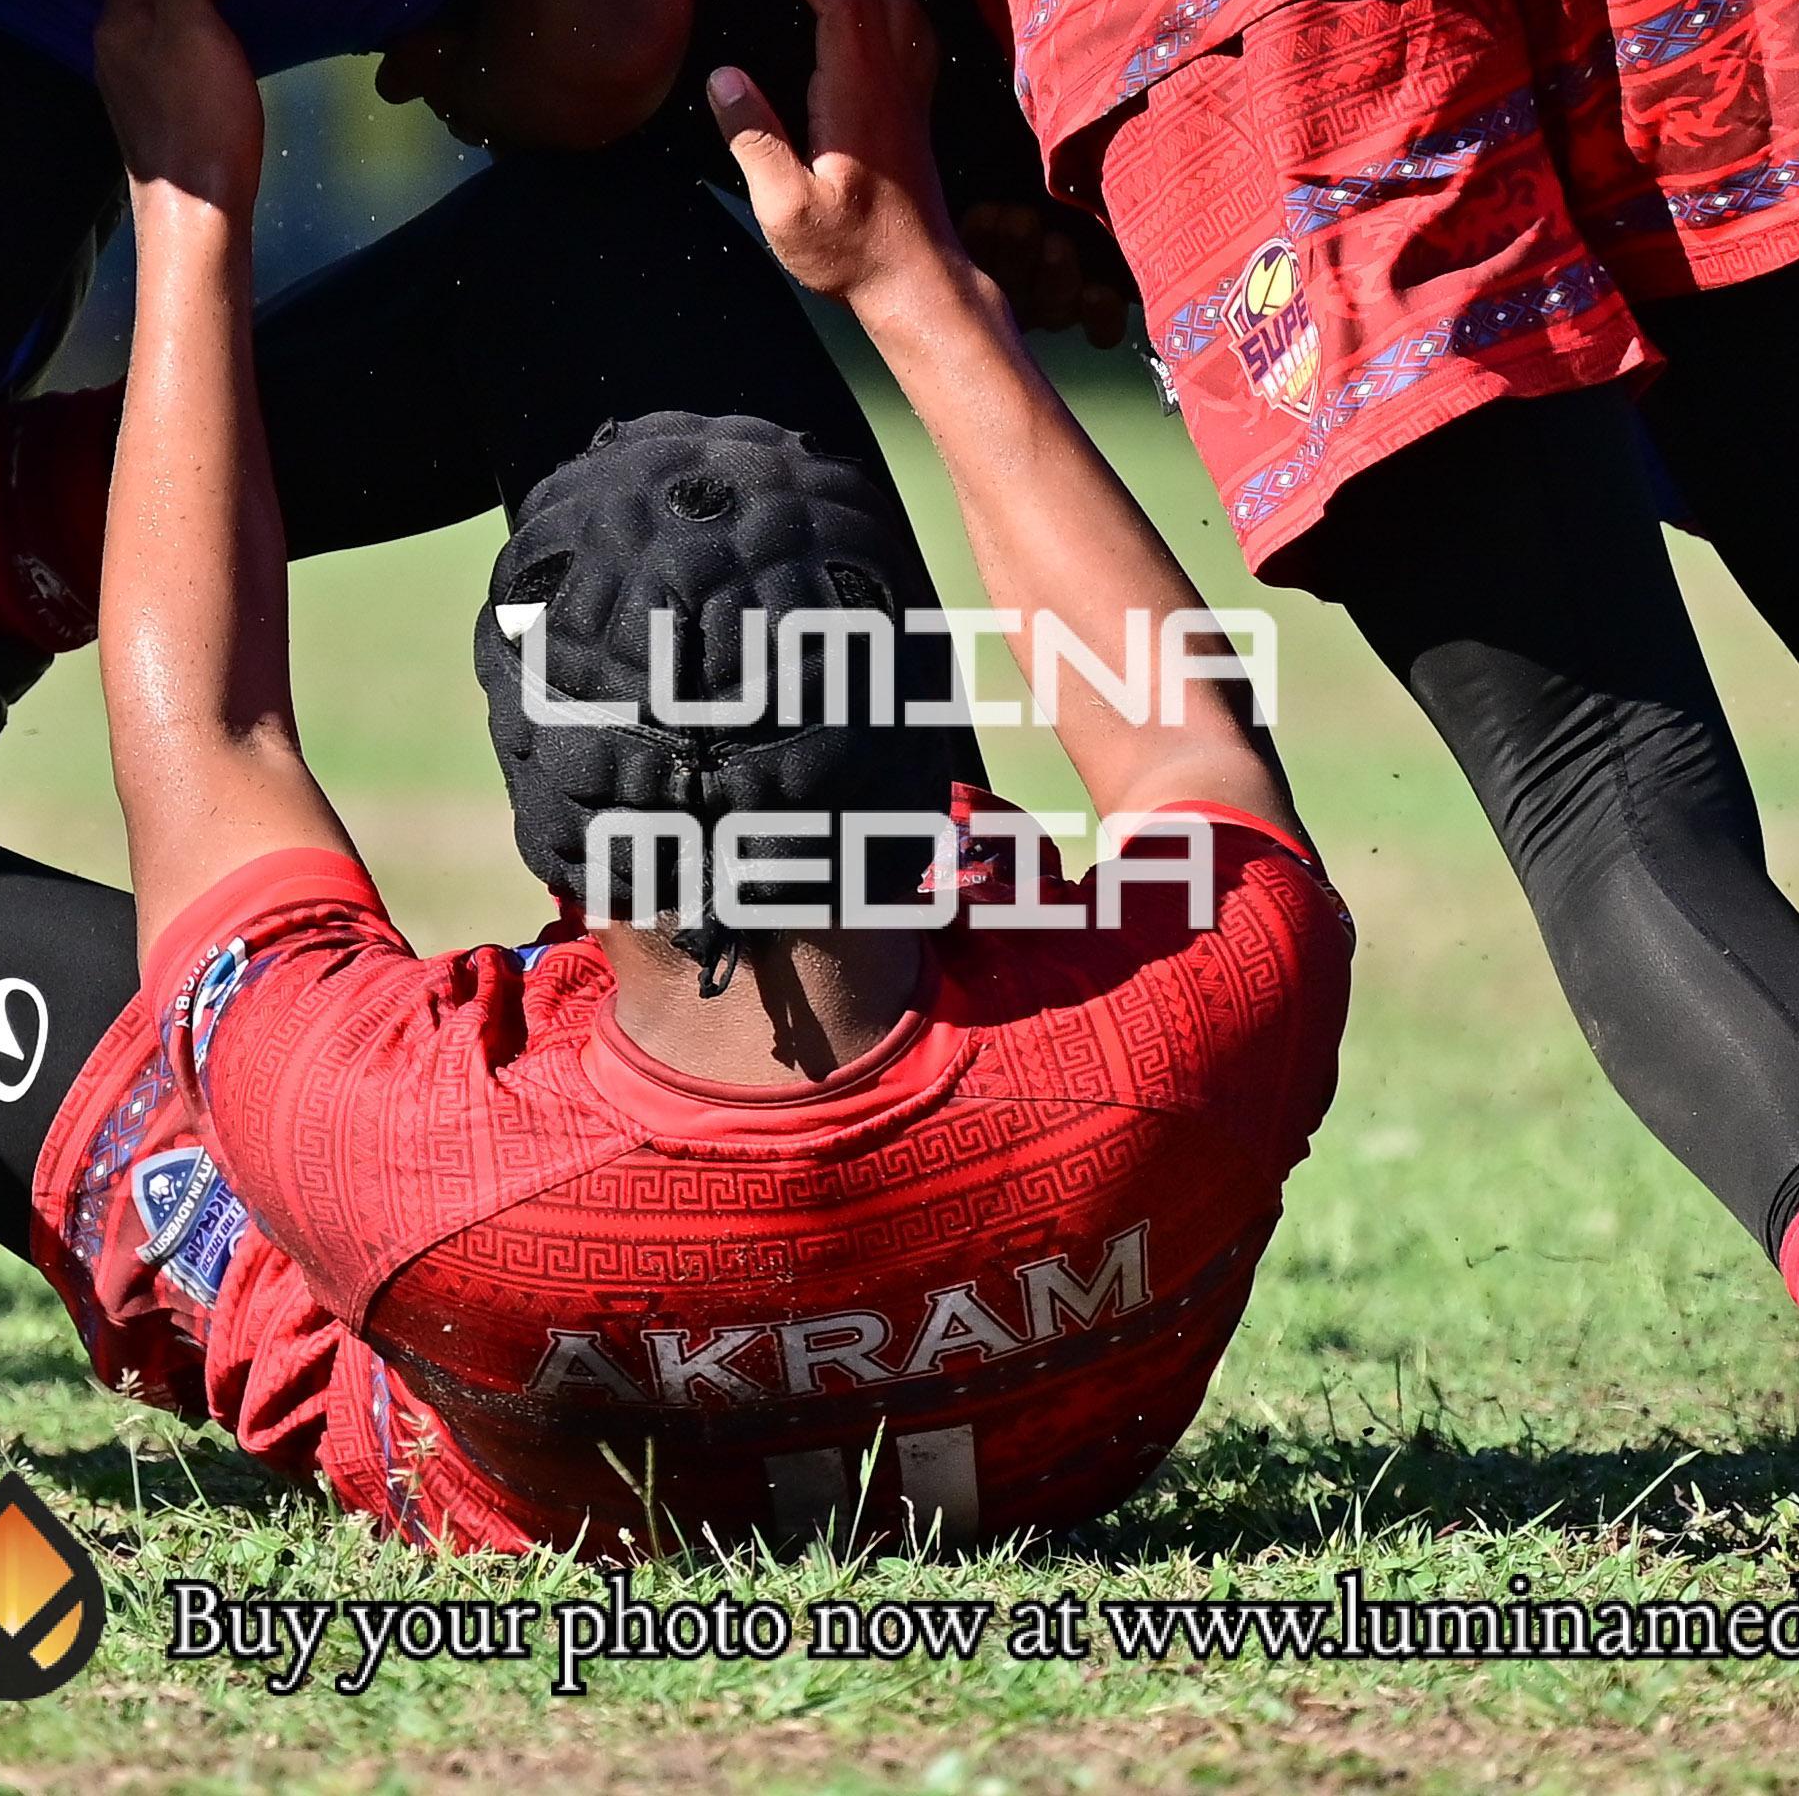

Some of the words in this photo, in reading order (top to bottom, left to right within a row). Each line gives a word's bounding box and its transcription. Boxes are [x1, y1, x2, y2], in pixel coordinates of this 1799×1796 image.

[1239, 288, 1310, 384] SUPE
[150, 1199, 196, 1254] ADVERSITY
[522, 1218, 1156, 1405] AKRAM
